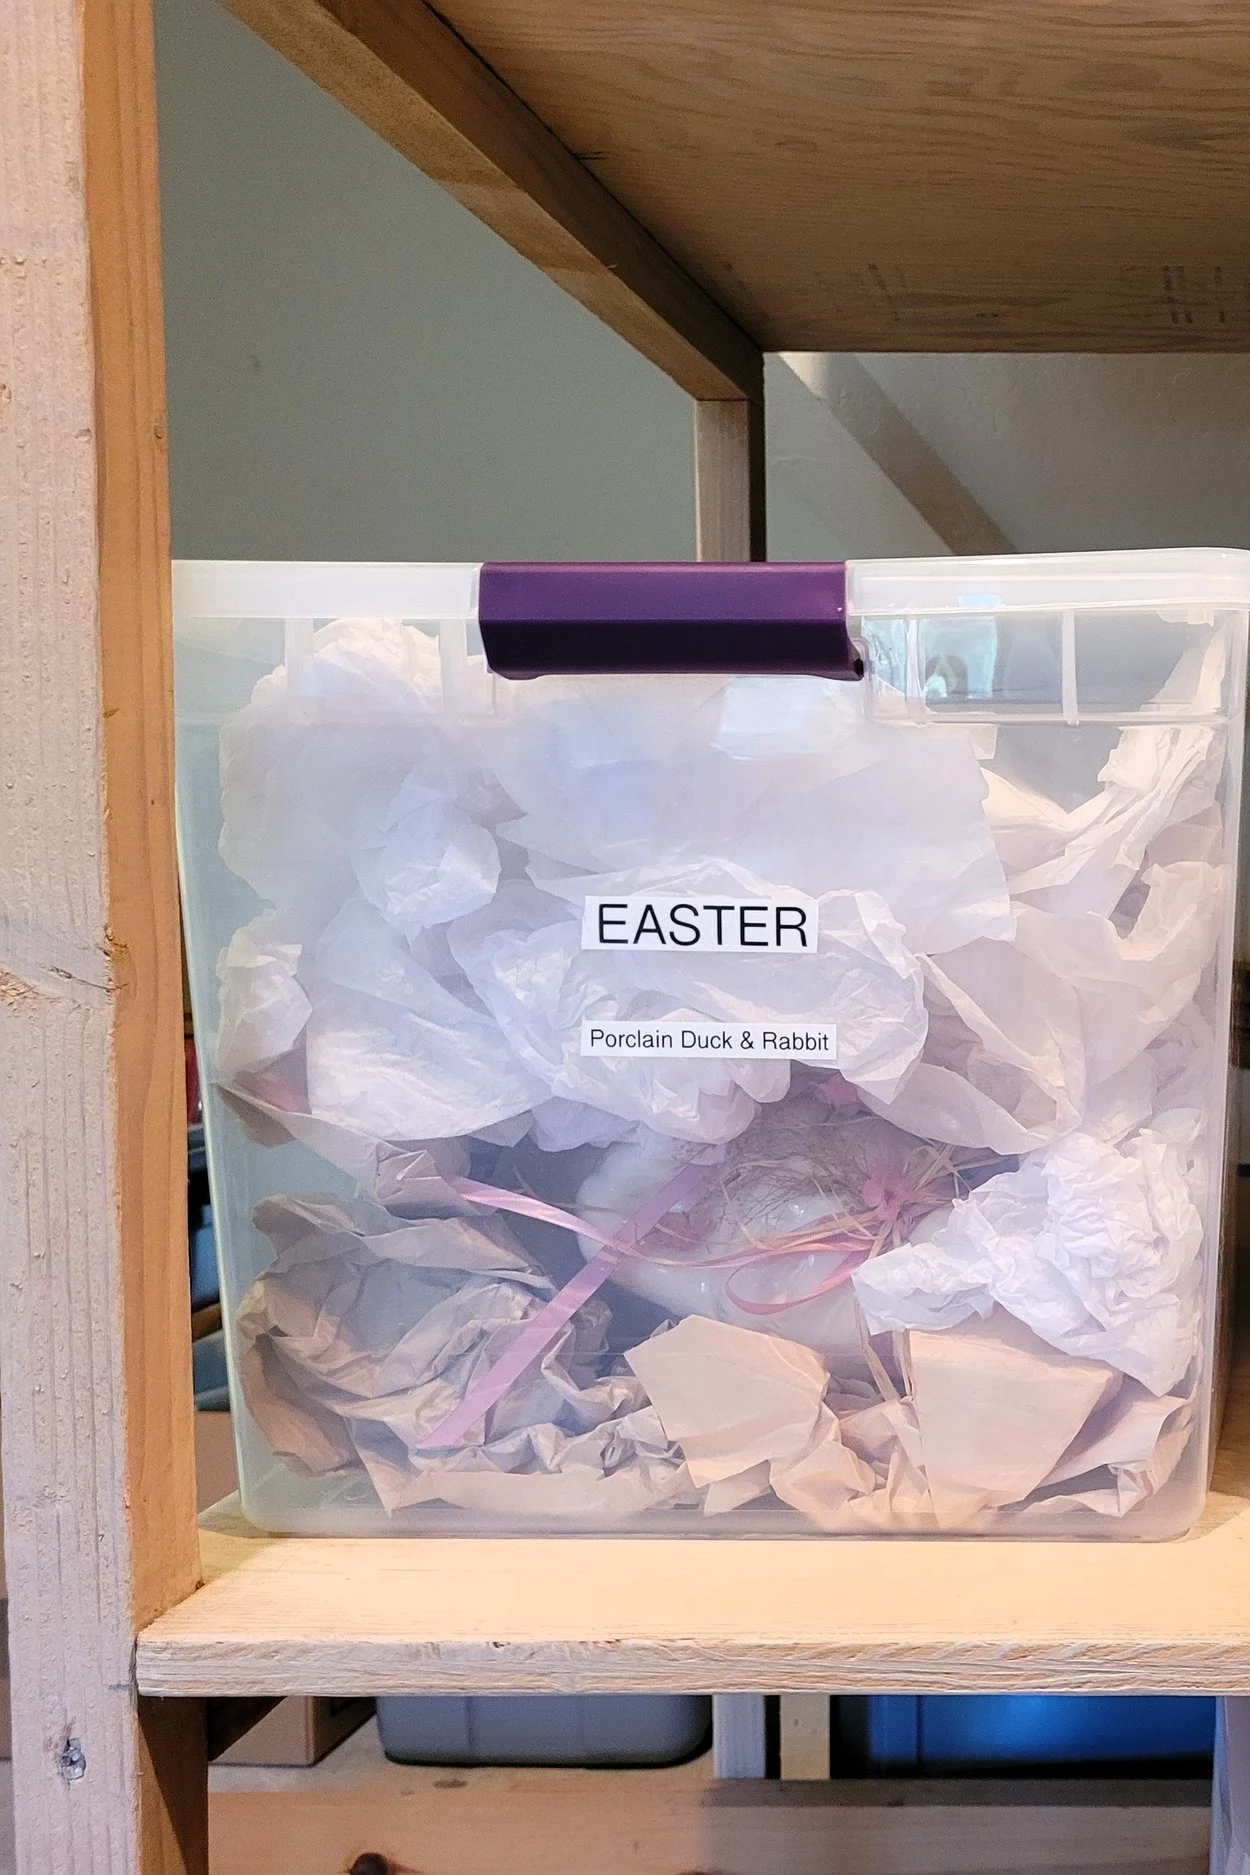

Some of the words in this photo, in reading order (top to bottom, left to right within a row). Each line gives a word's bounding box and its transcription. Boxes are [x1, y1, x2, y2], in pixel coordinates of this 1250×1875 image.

[598, 903, 808, 947] EASTER
[590, 1029, 673, 1048] Porclain
[681, 1030, 733, 1049] Duck
[740, 1030, 754, 1049] &
[762, 1031, 829, 1051] Rabbit
